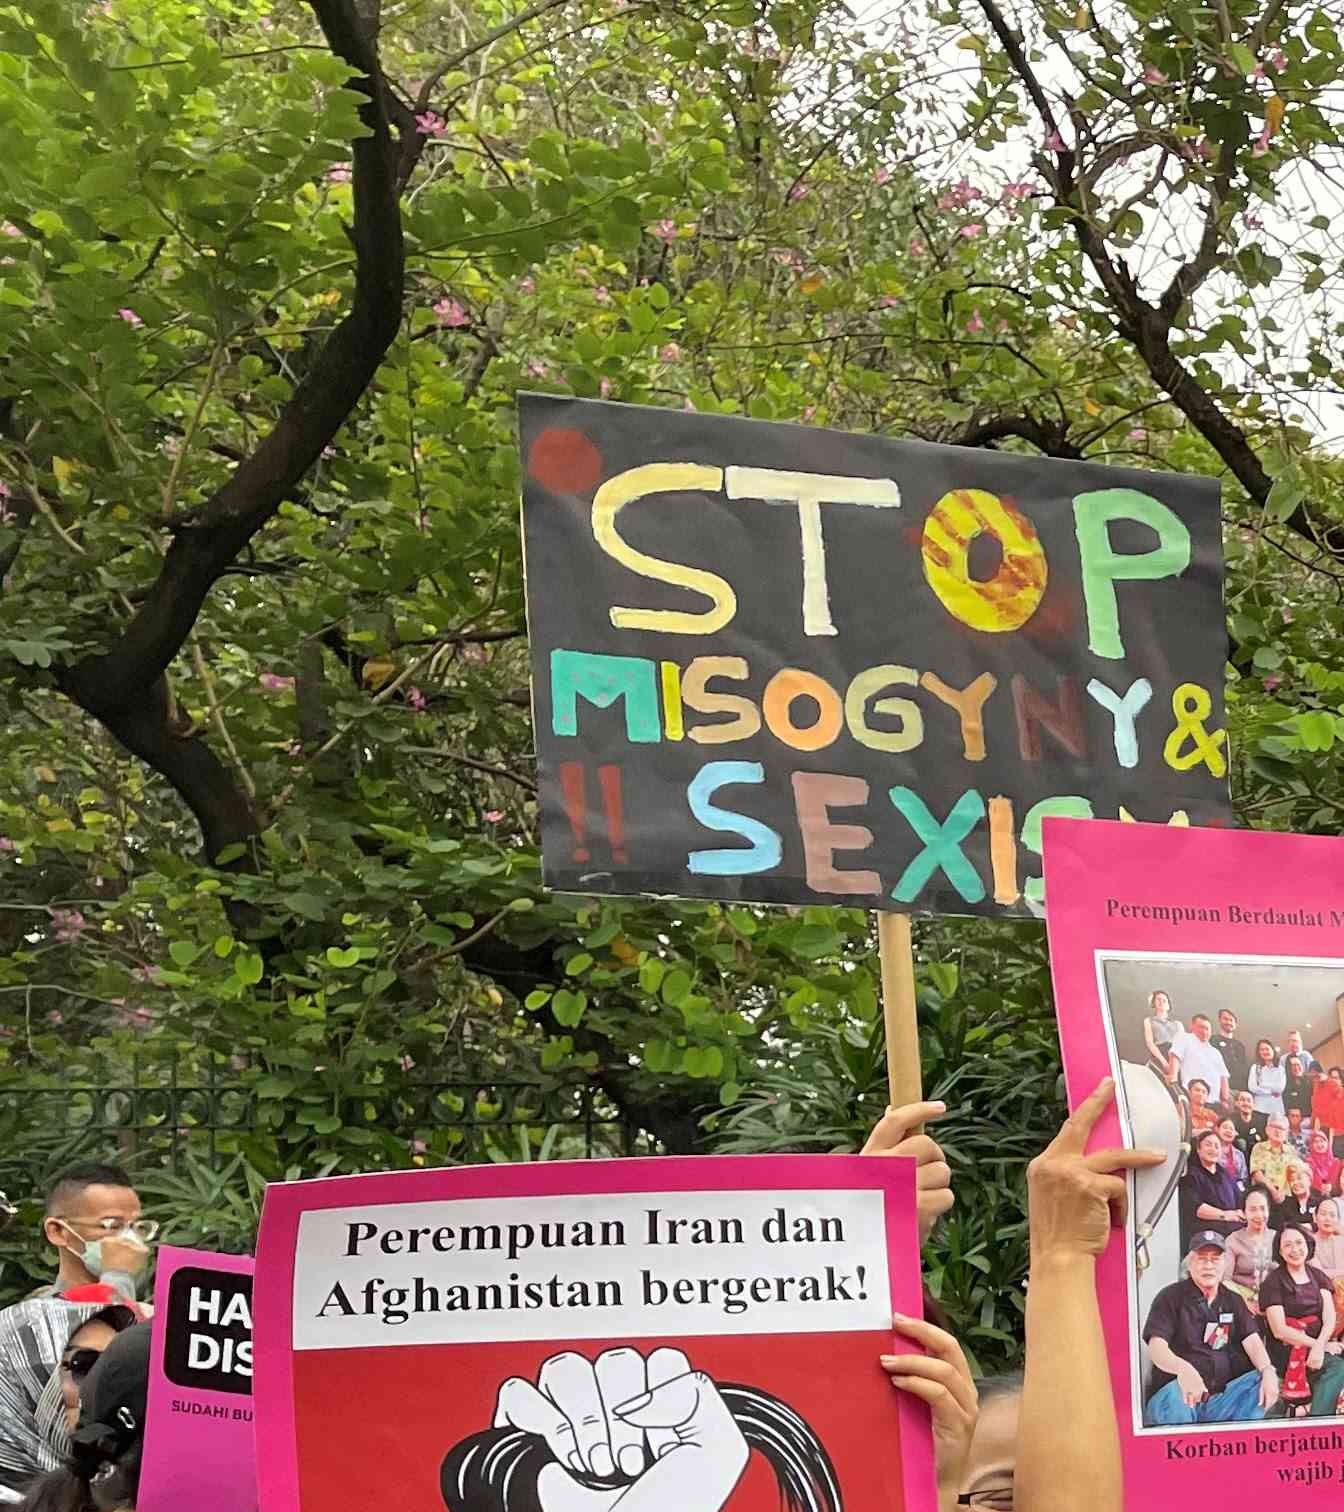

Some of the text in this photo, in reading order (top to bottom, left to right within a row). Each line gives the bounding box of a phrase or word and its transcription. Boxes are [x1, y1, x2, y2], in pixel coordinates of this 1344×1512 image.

[591, 461, 1192, 660] STOP
[549, 648, 1227, 779] MISOGYNY &
[1107, 899, 1221, 926] Perempuan
[1228, 904, 1324, 929] Berdaulat
[343, 1207, 846, 1259] Perempuan Iran dan
[315, 1265, 870, 1326] Afghanistan bergerak!
[171, 1399, 230, 1419] SUDAHI
[1166, 1437, 1248, 1461] Korban
[1276, 1460, 1335, 1487] wajib
